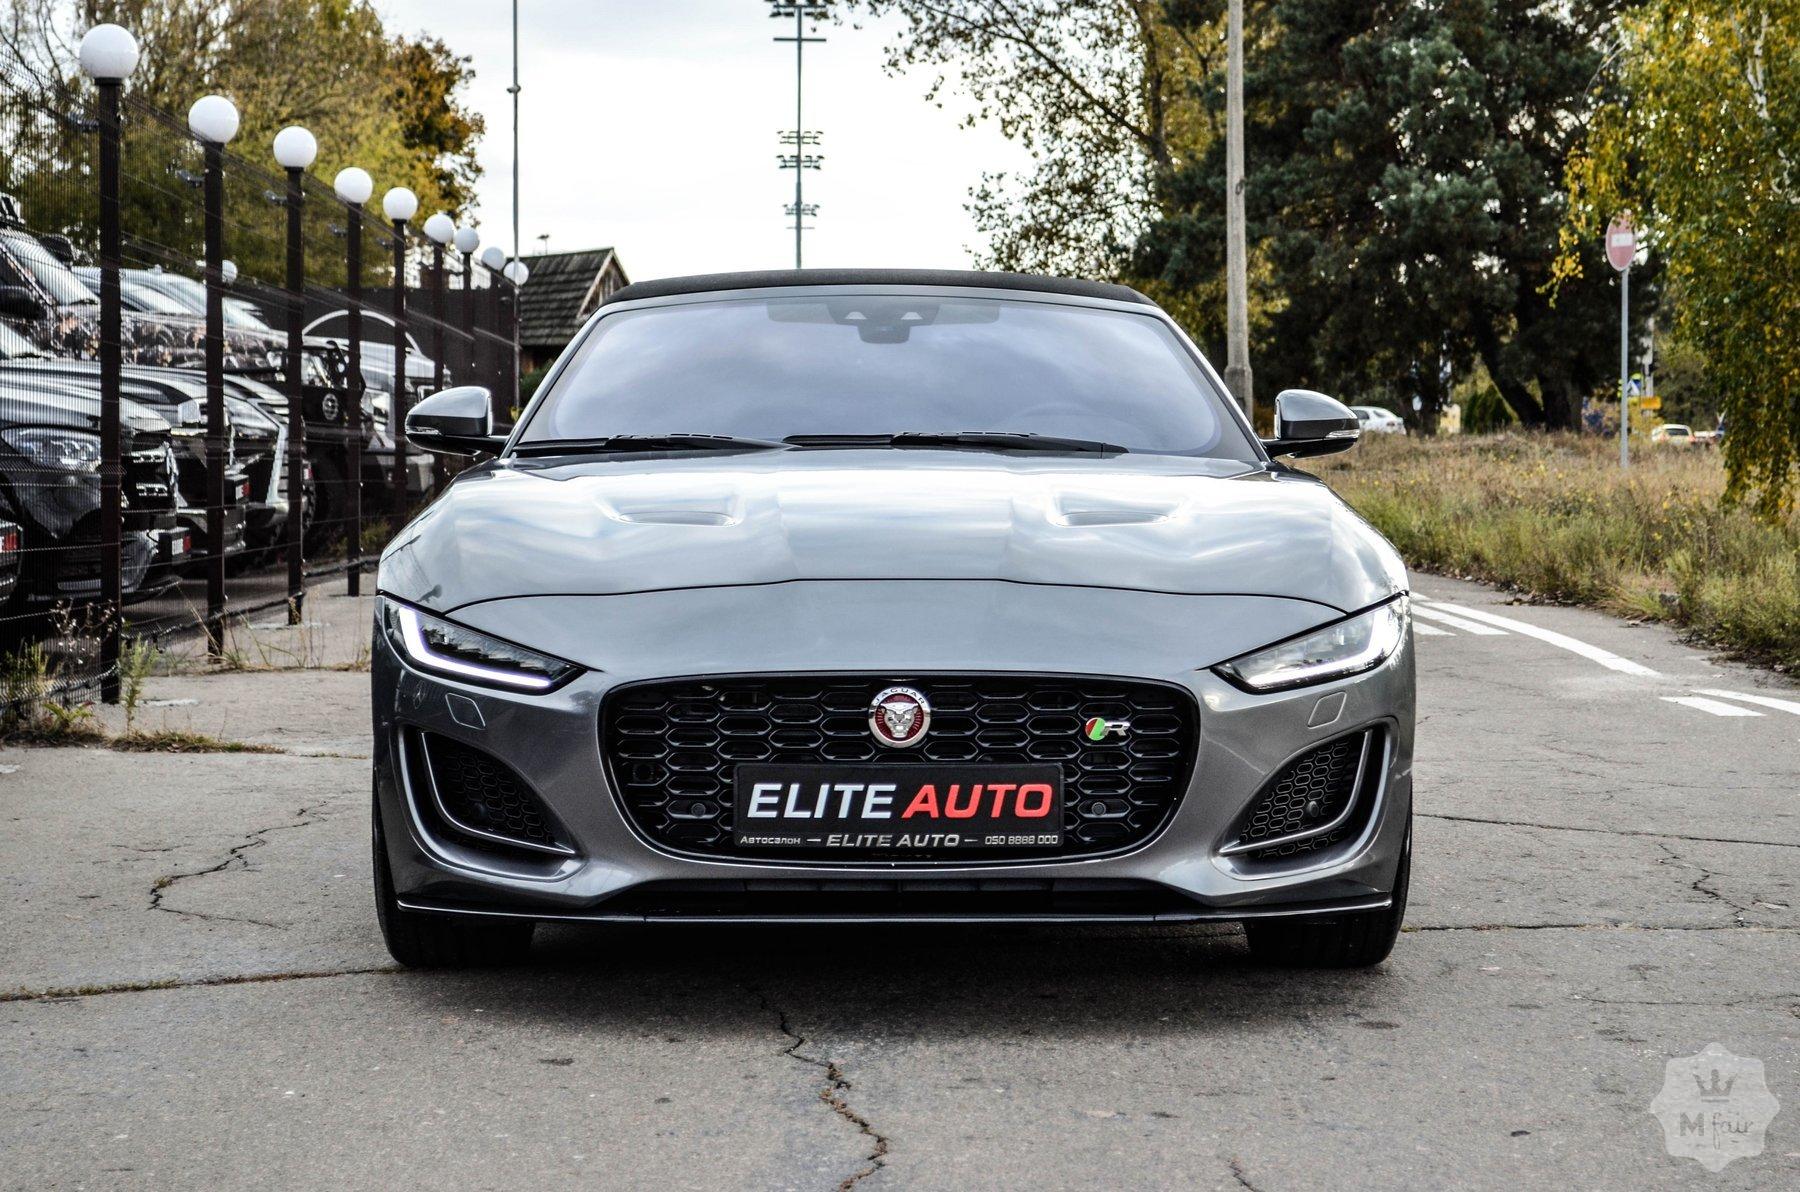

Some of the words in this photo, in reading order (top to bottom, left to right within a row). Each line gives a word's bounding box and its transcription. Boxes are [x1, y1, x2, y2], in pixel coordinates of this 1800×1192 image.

[874, 687, 925, 705] JAGUAR
[747, 782, 897, 819] ELITE
[901, 783, 1053, 819] AUTO
[740, 835, 801, 845] Автосалон
[826, 833, 893, 848] ELITE
[896, 834, 960, 848] AUTO
[984, 835, 1006, 846] 050
[1037, 834, 1059, 845] 000
